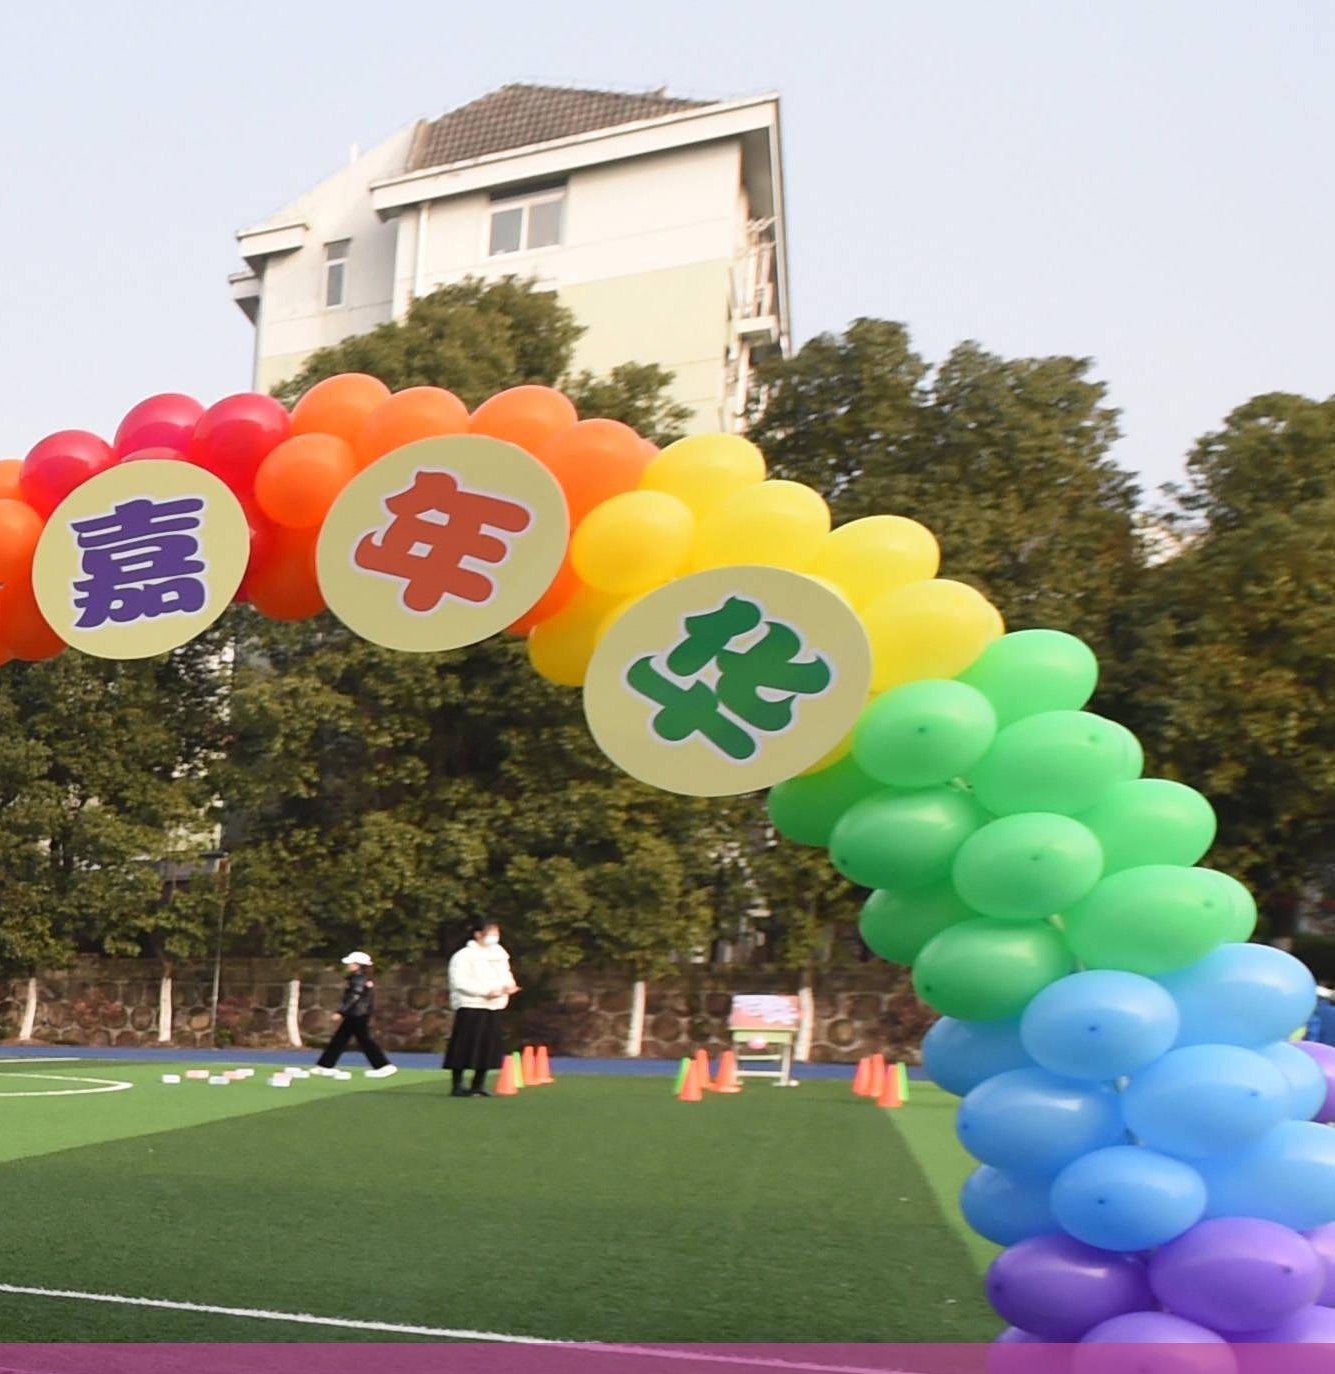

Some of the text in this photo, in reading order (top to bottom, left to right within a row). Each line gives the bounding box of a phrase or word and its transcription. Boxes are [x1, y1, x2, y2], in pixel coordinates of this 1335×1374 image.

[72, 498, 205, 628] 嘉
[354, 470, 532, 613] 年
[627, 595, 832, 760] 华
